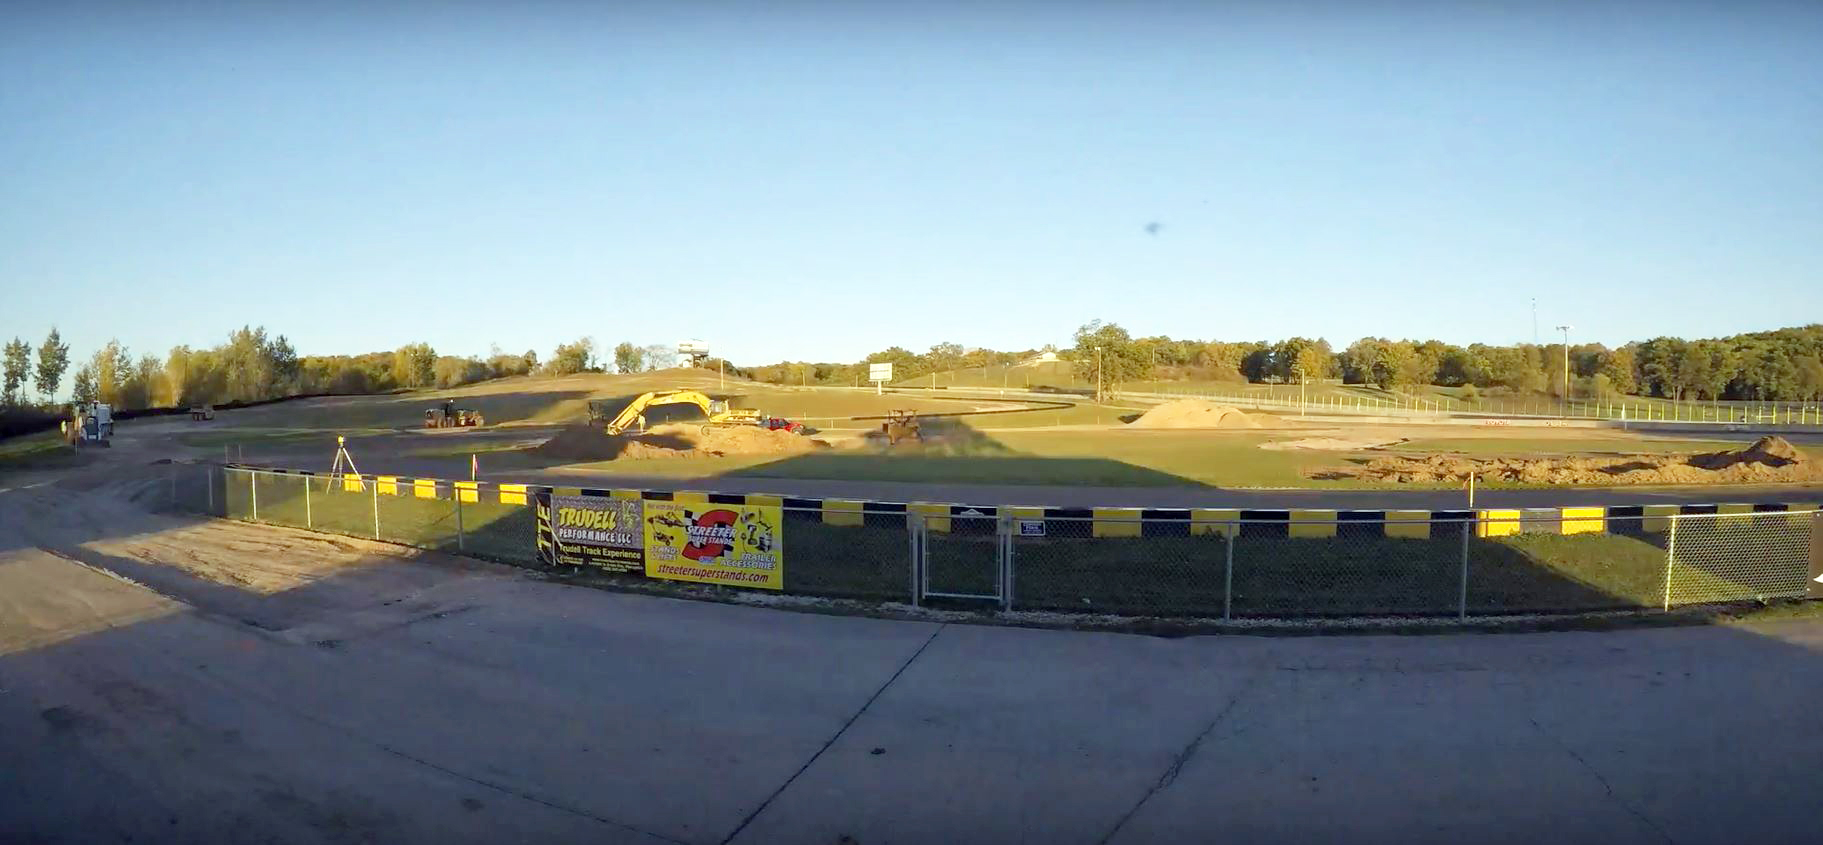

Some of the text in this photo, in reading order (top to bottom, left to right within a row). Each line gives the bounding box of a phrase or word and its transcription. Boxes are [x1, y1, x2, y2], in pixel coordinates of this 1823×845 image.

[559, 507, 617, 530] TRUDELL
[560, 528, 615, 543] PERFORMANCE
[687, 525, 737, 538] STREETER
[560, 545, 641, 559] Trudell Track Experience
[720, 560, 776, 570] ACCESSORIES
[657, 564, 768, 583] streetersuperstands.com
